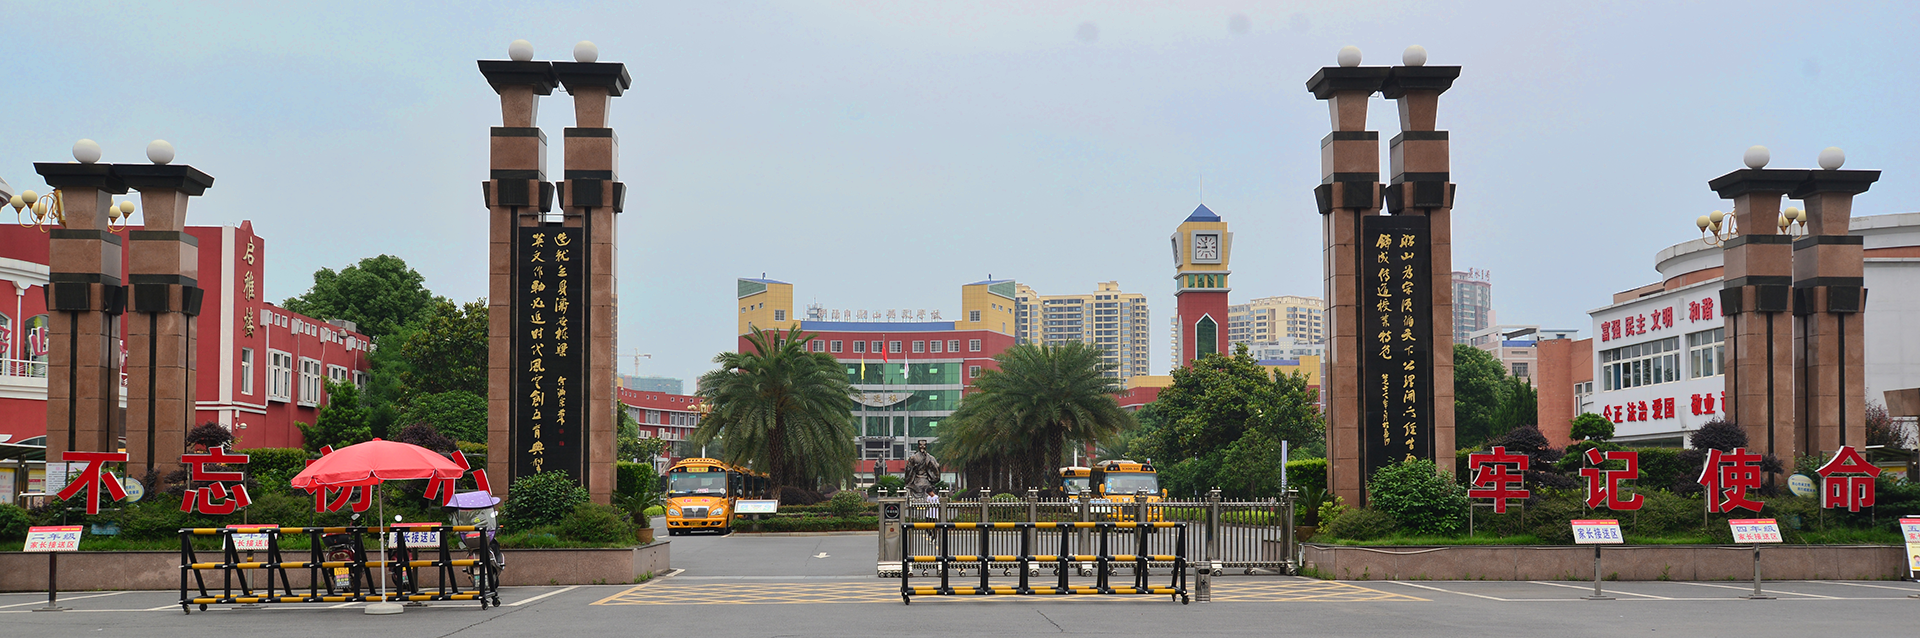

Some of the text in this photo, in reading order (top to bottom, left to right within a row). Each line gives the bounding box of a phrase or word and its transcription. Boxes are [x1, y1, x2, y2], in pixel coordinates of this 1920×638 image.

[1601, 319, 1622, 342] 富强
[1625, 313, 1647, 337] 民主
[1650, 306, 1673, 332] 文明
[1688, 297, 1714, 323] 和谐
[1602, 404, 1624, 424] 公正
[1626, 400, 1648, 422] 法治
[1652, 397, 1675, 420] 爱国
[1690, 393, 1716, 416] 敬业
[1736, 525, 1776, 533] 四年级
[31, 533, 76, 541] 二年级
[1577, 527, 1619, 540] 家长接送区
[1737, 533, 1779, 541] 家长接送区
[29, 541, 75, 549] 家长接送区
